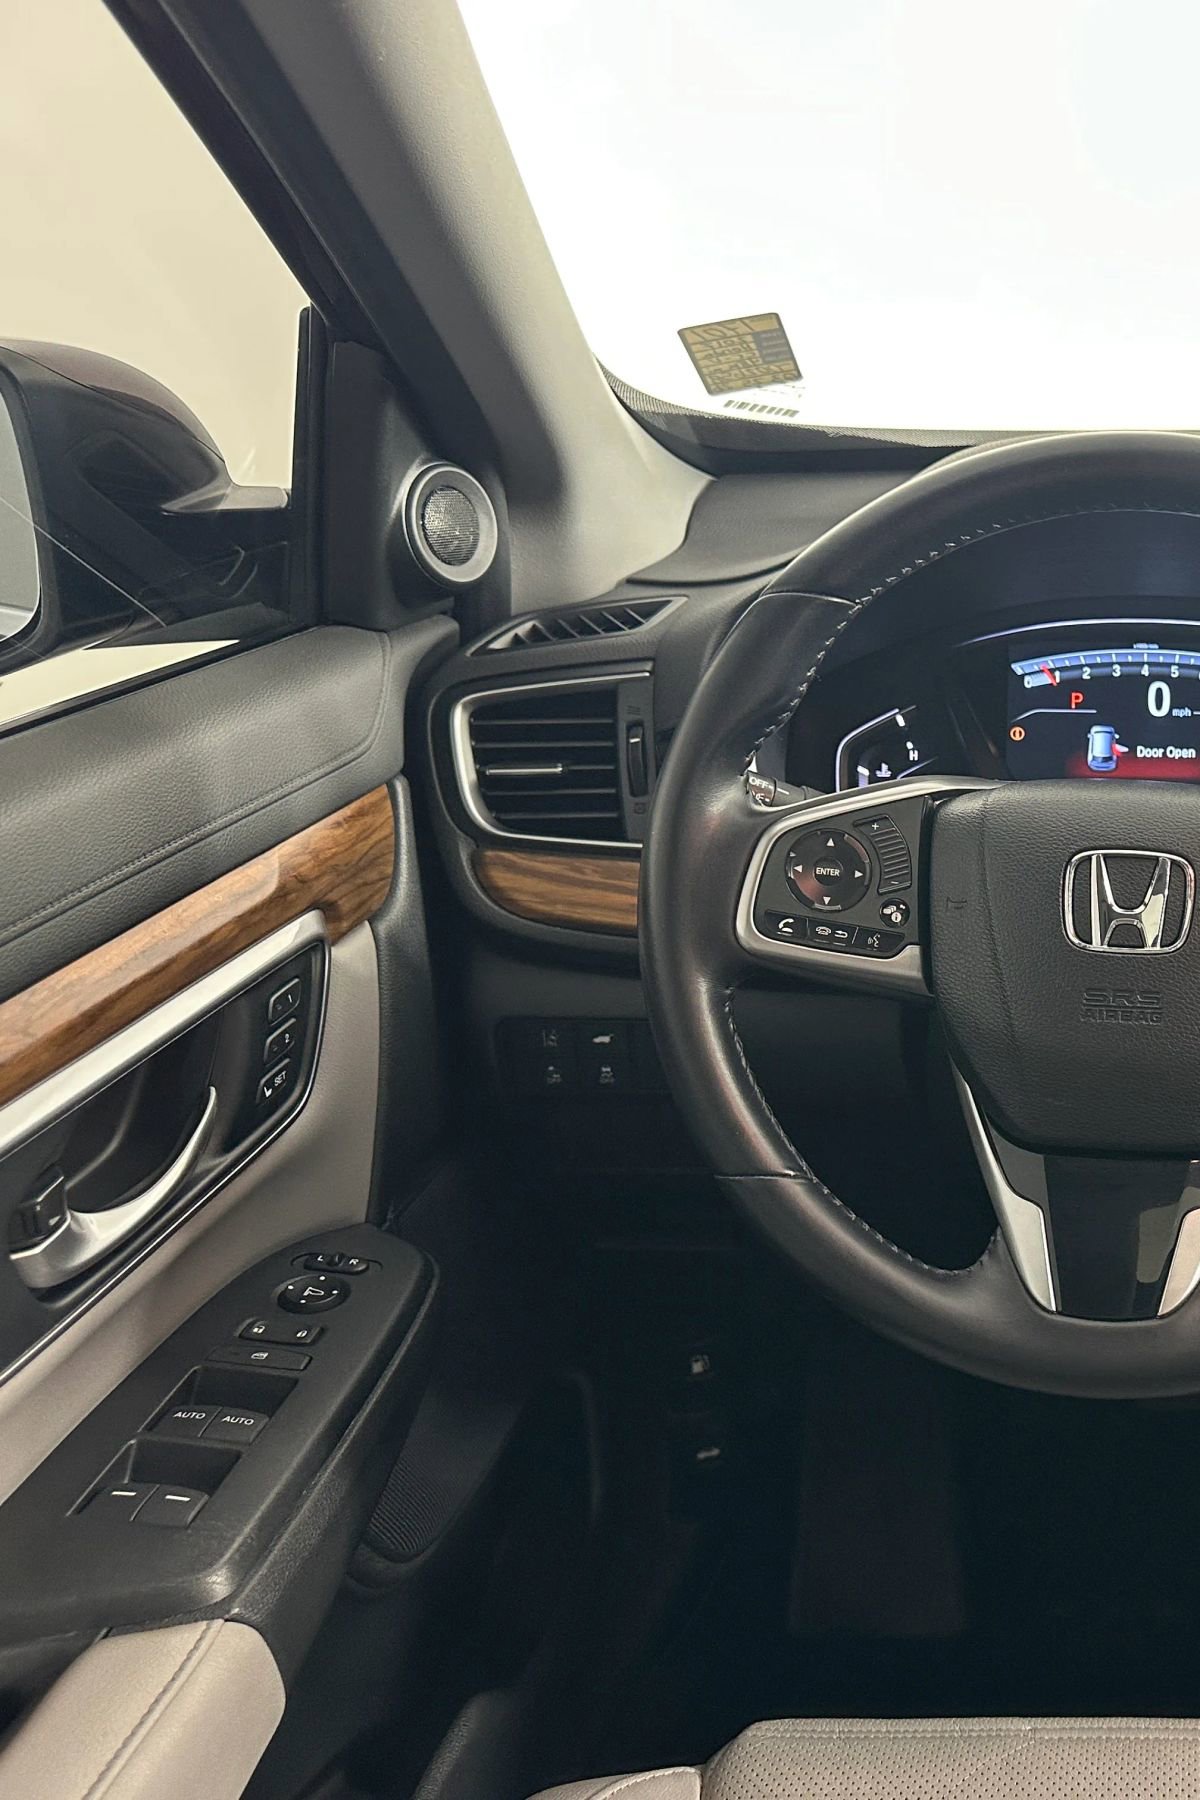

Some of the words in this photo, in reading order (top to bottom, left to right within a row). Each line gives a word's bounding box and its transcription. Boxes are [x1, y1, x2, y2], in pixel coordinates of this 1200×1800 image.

[1024, 675, 1033, 688] 0
[1082, 667, 1091, 679] 2
[1112, 664, 1121, 677] 3
[1141, 664, 1149, 677] 4
[1171, 666, 1179, 678] 5
[1071, 692, 1084, 709] P
[1147, 681, 1171, 718] 0
[1172, 706, 1191, 718] mph
[909, 749, 918, 761] H
[1136, 746, 1164, 758] Door
[1166, 746, 1196, 760] Open
[816, 867, 841, 877] ENTER
[1083, 988, 1162, 1008] SRS
[1080, 1008, 1162, 1026] AIRBAG
[274, 1070, 287, 1087] SET
[173, 1411, 206, 1420] AUTO
[222, 1415, 254, 1425] AUTO
